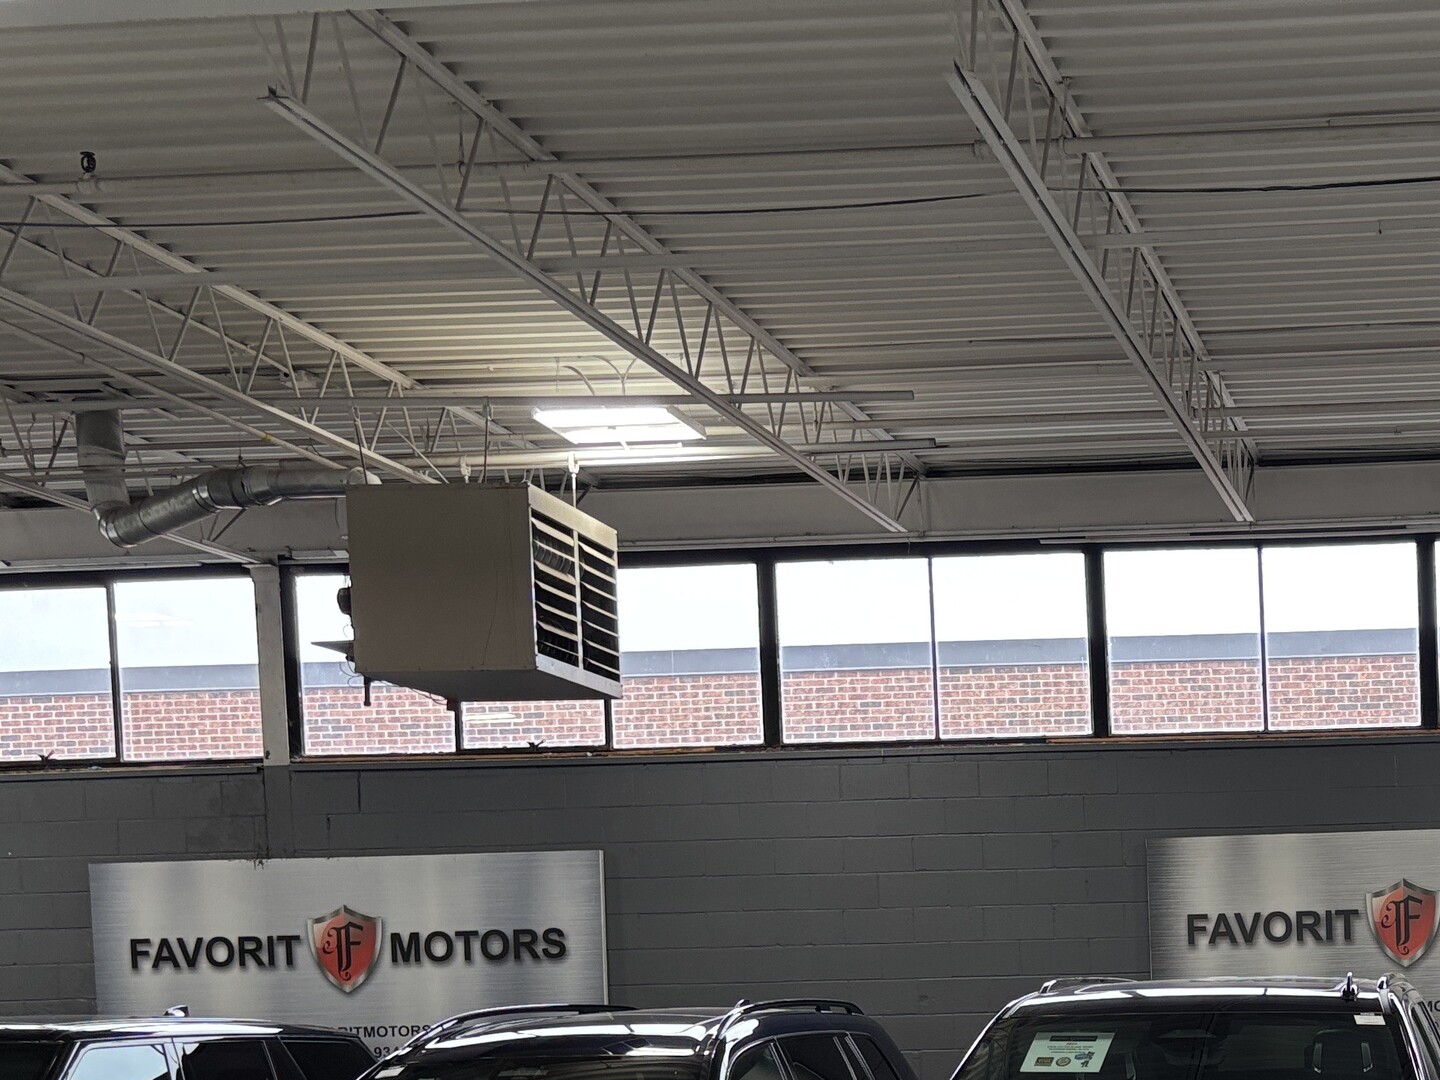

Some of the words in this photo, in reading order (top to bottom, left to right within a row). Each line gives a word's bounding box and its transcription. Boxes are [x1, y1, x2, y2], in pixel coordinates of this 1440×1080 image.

[1187, 908, 1359, 945] FAVORIT
[130, 935, 300, 969] FAVORIT
[391, 927, 567, 963] MOTORS
[338, 1025, 432, 1038] TMOTOR
